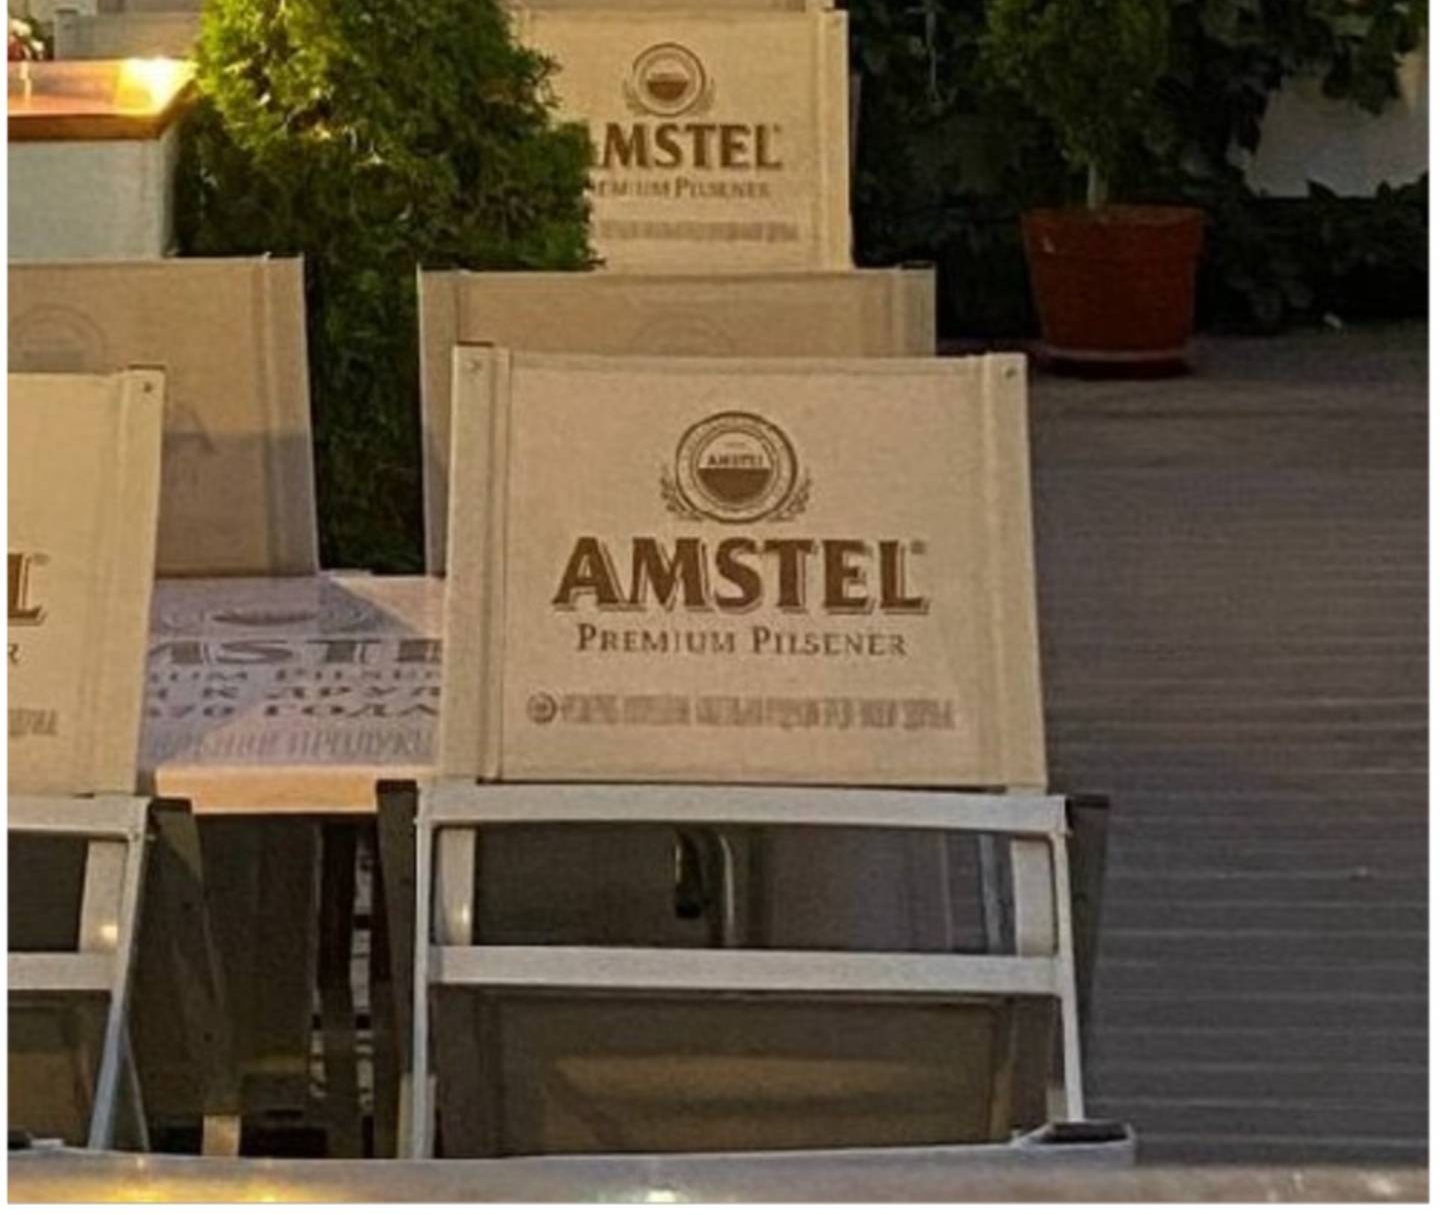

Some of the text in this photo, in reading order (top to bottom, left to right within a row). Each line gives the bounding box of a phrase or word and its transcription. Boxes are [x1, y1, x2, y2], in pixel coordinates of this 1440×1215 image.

[596, 122, 784, 171] MSTEL
[553, 536, 930, 615] AMSTEL
[575, 623, 908, 657] PREMIUM PILSENER
